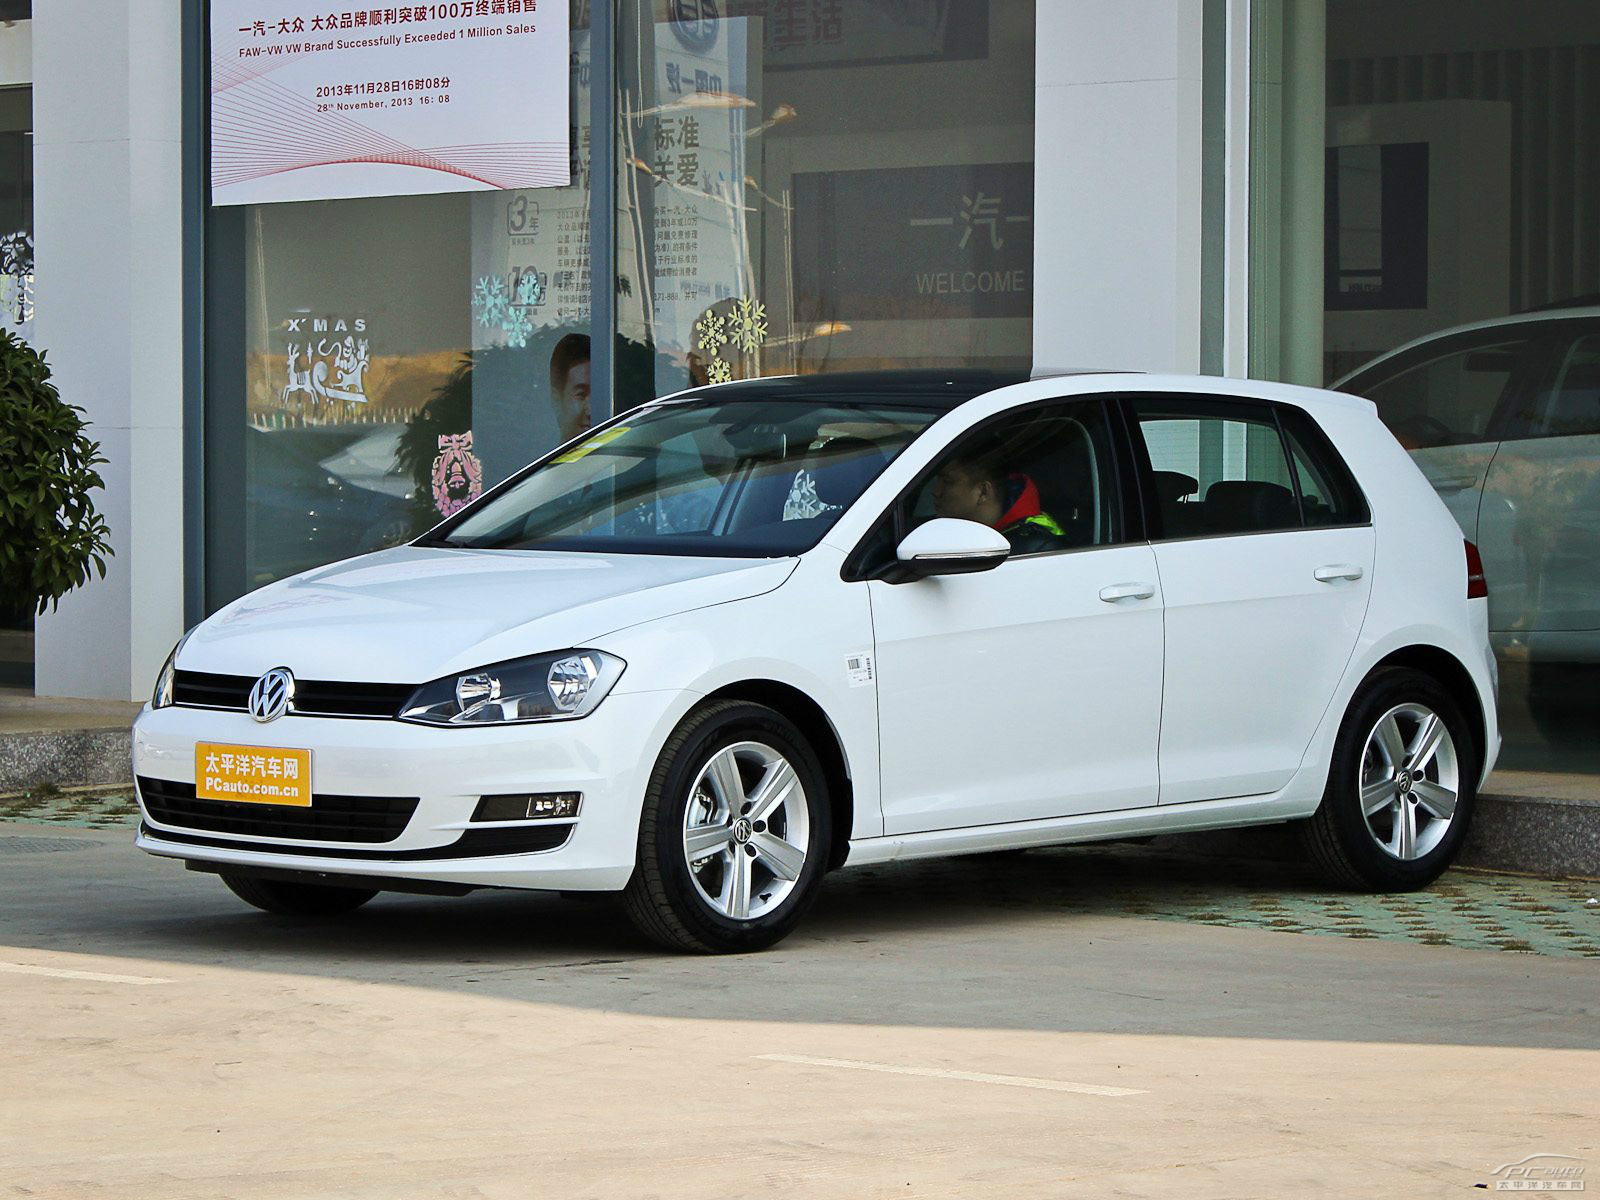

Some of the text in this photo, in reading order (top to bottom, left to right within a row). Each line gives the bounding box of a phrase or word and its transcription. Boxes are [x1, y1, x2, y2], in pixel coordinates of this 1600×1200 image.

[238, 0, 537, 38] 一汽-大众 大众品牌顺利突破100万终端销售
[239, 23, 537, 58] FAW-VW VW Brand Successfully Exceeded 1 Million Sales
[316, 76, 451, 98] 2013年11月28日16时08分
[337, 99, 389, 112] November,
[391, 97, 414, 107] 2013
[916, 270, 1025, 294] WELCOME
[205, 752, 299, 782] 太平洋汽车网
[205, 776, 299, 797] PCauto.com.cn
